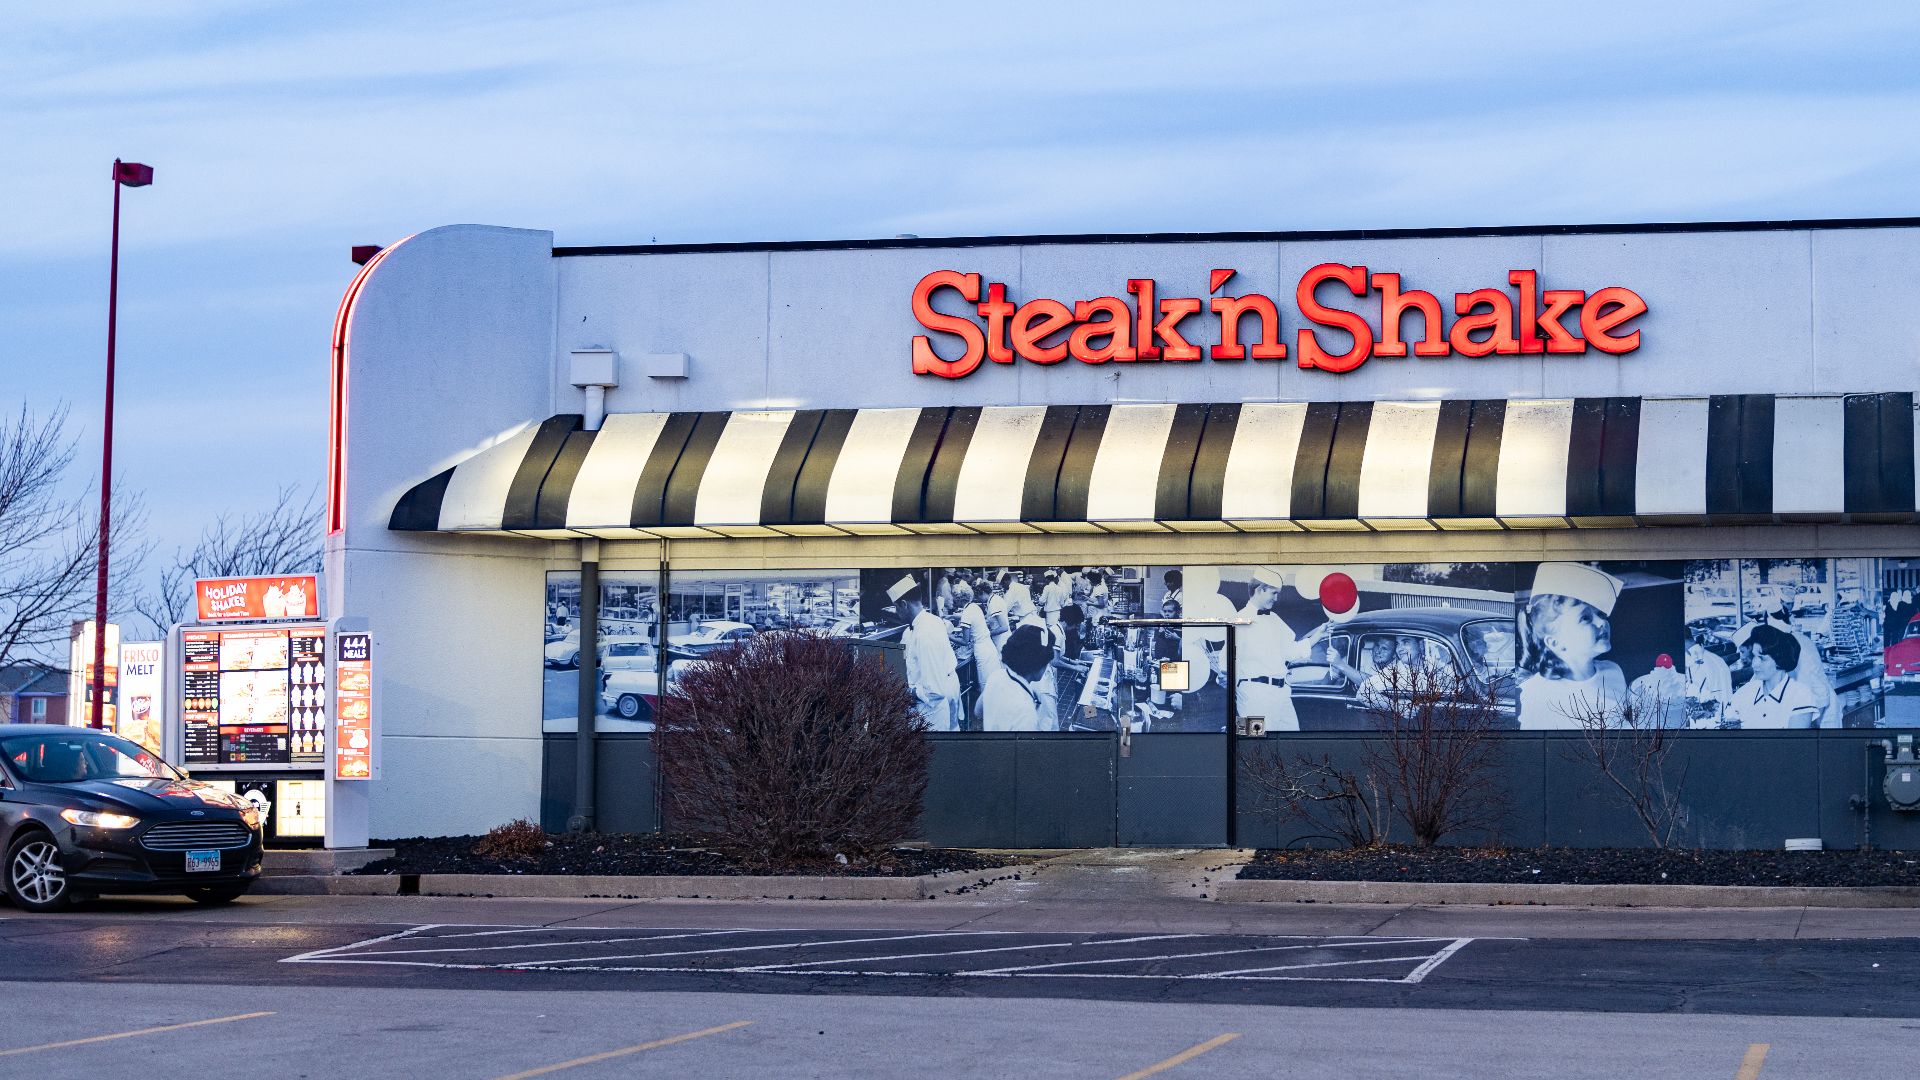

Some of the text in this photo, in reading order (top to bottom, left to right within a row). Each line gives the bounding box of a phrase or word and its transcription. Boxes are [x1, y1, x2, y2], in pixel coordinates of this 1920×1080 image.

[911, 269, 1202, 379] Steak
[1295, 263, 1649, 374] Shake
[205, 582, 248, 600] HOLIDAY
[211, 595, 246, 612] SHAKES
[124, 648, 159, 663] FRISCO
[343, 648, 367, 659] MEALS
[126, 663, 155, 676] MELT
